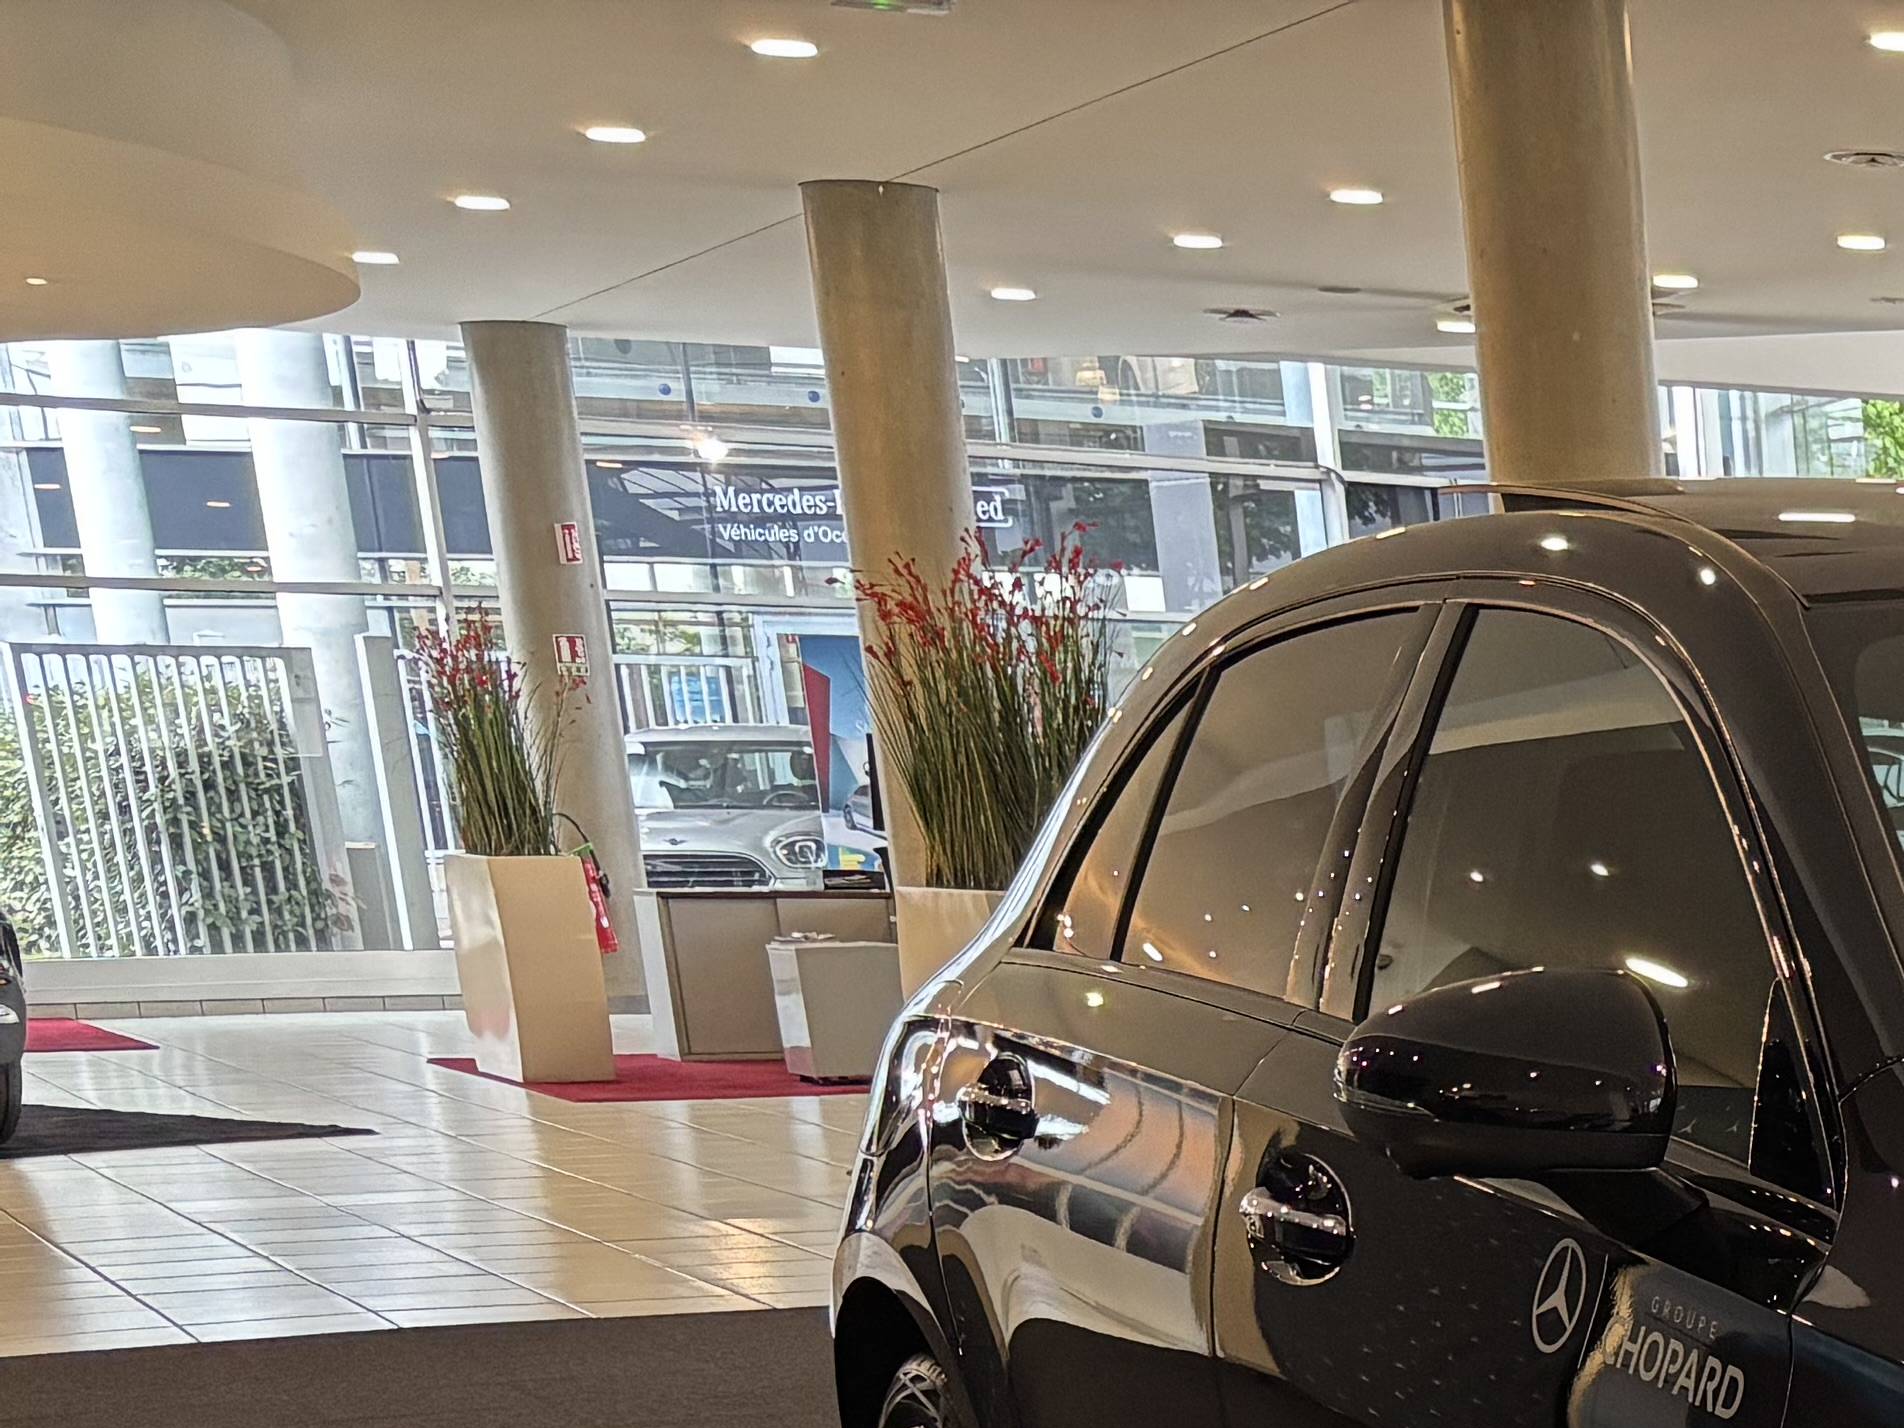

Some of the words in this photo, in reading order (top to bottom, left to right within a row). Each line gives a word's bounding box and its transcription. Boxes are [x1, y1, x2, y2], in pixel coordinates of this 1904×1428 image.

[714, 486, 845, 514] Mercedes-
[718, 524, 799, 543] Véhicules
[1651, 1296, 1719, 1340] GROUPE
[1602, 1320, 1745, 1419] CHOPARD
